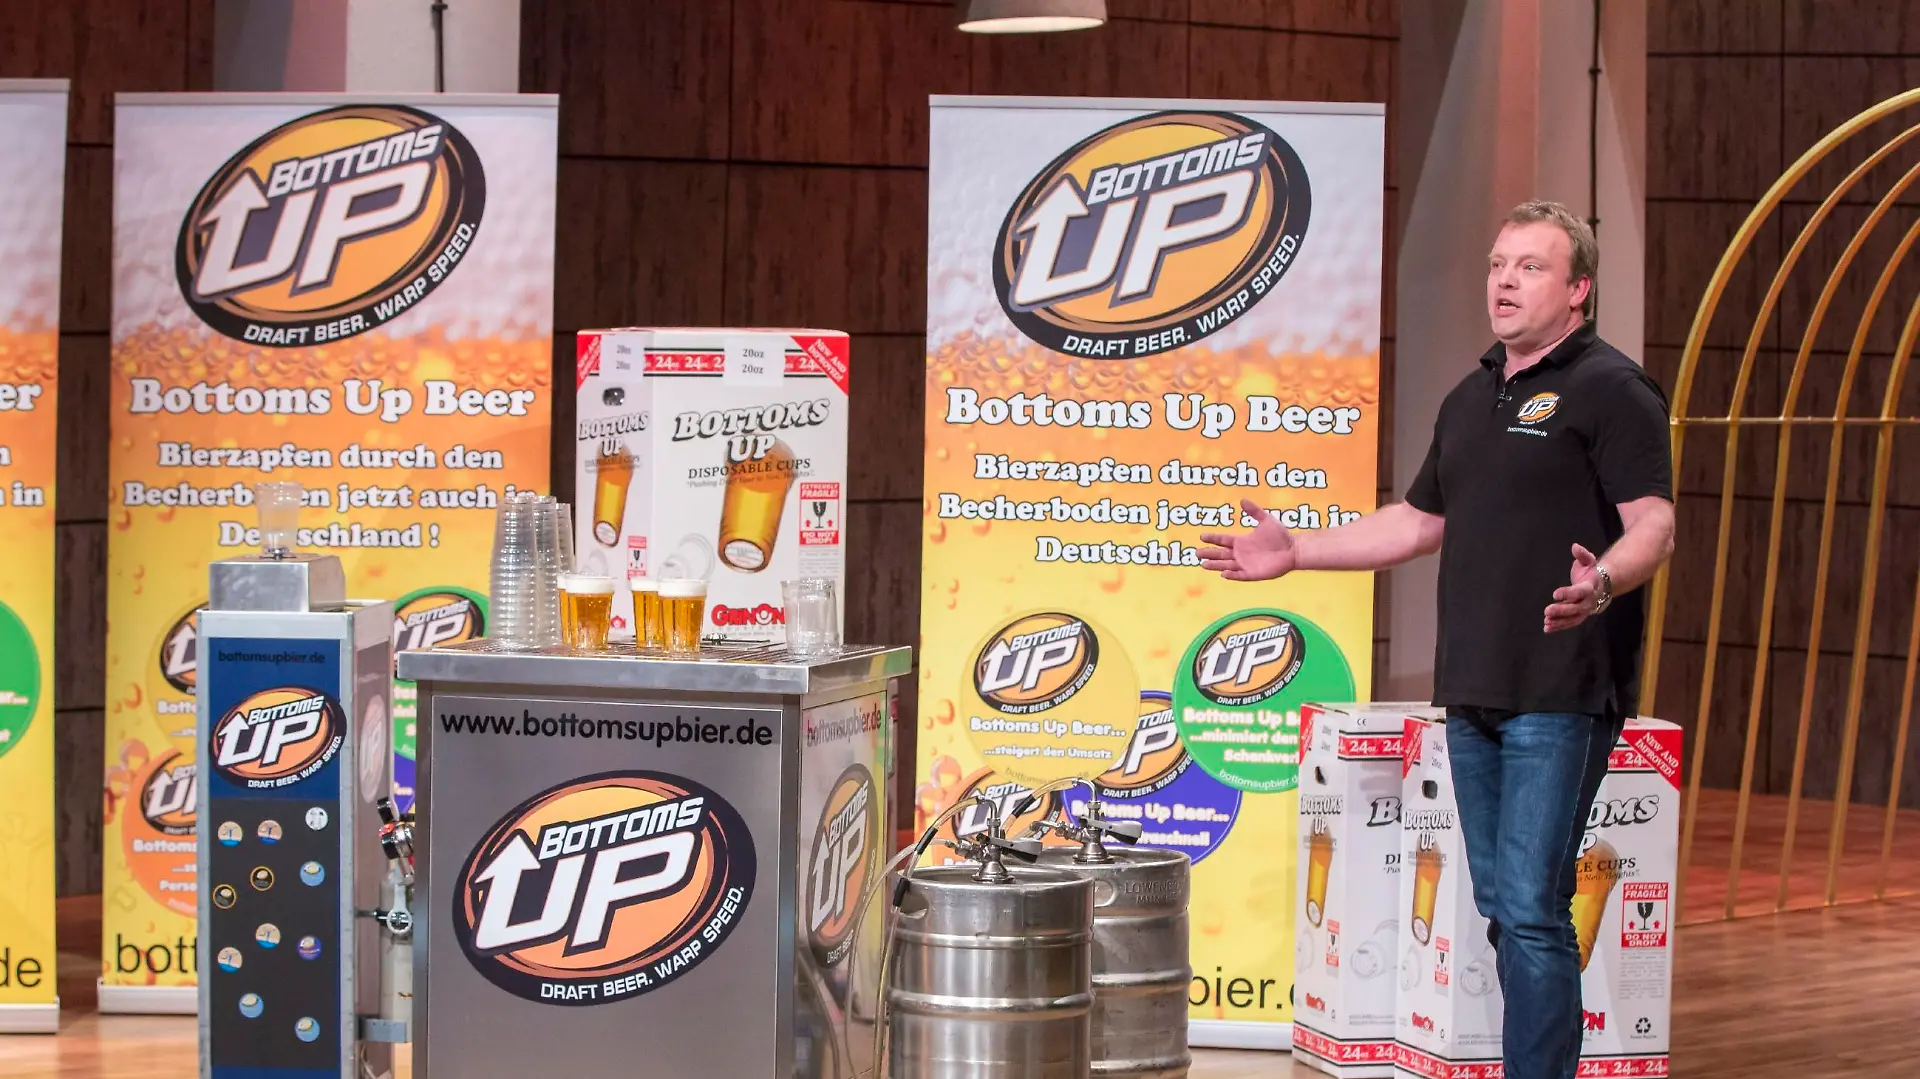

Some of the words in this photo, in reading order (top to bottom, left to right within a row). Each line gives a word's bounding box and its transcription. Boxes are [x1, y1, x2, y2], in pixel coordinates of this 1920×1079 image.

[267, 125, 442, 198] BOTTOMS
[1087, 132, 1265, 206] BOTTOMS
[198, 163, 431, 296] UP
[1014, 170, 1254, 304] UP
[244, 324, 310, 345] DRAFT
[314, 316, 370, 340] BEER.
[374, 276, 428, 322] WARP
[429, 221, 476, 282] SPEED.
[1063, 335, 1129, 357] DRAFT
[1134, 329, 1191, 354] BEER.
[1197, 290, 1251, 335] WARP
[1252, 233, 1300, 295] SPEED.
[743, 348, 764, 358] 20oz
[742, 364, 763, 374] 20oz
[0, 384, 43, 411] er
[130, 378, 330, 415] Bottoms
[343, 378, 413, 422] Up
[424, 380, 535, 417] Beer
[579, 411, 649, 440] BOTTOMS
[672, 398, 831, 442] BOTTOMS
[945, 387, 1152, 429] Bottoms
[1163, 393, 1235, 438] Up
[1245, 395, 1361, 434] Beer
[158, 443, 331, 472] Bierzapfen
[339, 444, 436, 469] durch
[444, 446, 502, 469] den
[602, 438, 624, 457] UP
[728, 434, 776, 463] UP
[688, 462, 772, 479] DISPOSABLE
[777, 458, 811, 471] CUPS
[974, 453, 1152, 487] Bierzapfen
[1159, 460, 1259, 488] durch
[1265, 462, 1327, 489] den
[12, 481, 44, 506] in
[123, 481, 330, 508] Becherben
[337, 484, 412, 513] jetzt
[419, 484, 497, 509] auch
[939, 493, 1150, 525] Becherboden
[1156, 500, 1235, 530] jetzt
[219, 521, 422, 547] Deschland
[1035, 536, 1209, 566] Deutschla
[407, 600, 470, 627] BOTTOMS
[1010, 622, 1082, 651] BOTTOMS
[1226, 622, 1291, 649] BOTTOMS
[218, 650, 326, 667] bottomsupbier.de
[982, 637, 1078, 692] UP
[1200, 637, 1286, 687] UP
[1001, 704, 1028, 713] DRAFT
[1029, 701, 1052, 712] BEER.
[1054, 688, 1076, 704] WARP
[1076, 663, 1096, 689] SPEED.
[1217, 696, 1241, 706] DRAFT
[1264, 681, 1284, 697] WARP
[248, 695, 325, 725] BOTTOMS
[1137, 709, 1175, 730] TTOM
[1183, 707, 1254, 725] Bottoms
[1257, 709, 1282, 730] Up
[218, 711, 321, 766] UP
[440, 709, 774, 748] www.bottomsupbier.de
[807, 703, 882, 747] bottomsupbier.de
[970, 716, 1041, 733] Bottoms
[1043, 719, 1068, 738] Up
[1072, 721, 1127, 737] Beer...
[1271, 731, 1298, 745] den
[248, 779, 275, 788] DRAFT
[276, 775, 301, 787] BEER.
[300, 760, 323, 779] WARP
[322, 735, 342, 762] SPEED.
[984, 746, 1041, 758] ...steigert
[1042, 747, 1065, 757] den
[1067, 748, 1112, 759] Umsatz
[1113, 723, 1178, 776] P
[1635, 738, 1676, 778] IMPROVED!
[1642, 732, 1664, 751] NEW
[1661, 752, 1679, 768] AND
[985, 782, 1028, 799] BOTT
[1102, 788, 1130, 798] DRAFT
[1131, 786, 1155, 797] BEER.
[1156, 772, 1178, 789] WARP
[1178, 755, 1194, 773] SPE
[829, 780, 869, 849] BOTTOMS
[1144, 802, 1171, 824] Up
[1173, 803, 1230, 822] Beer...
[1301, 795, 1343, 815] BOTTOMS
[1405, 808, 1455, 830] BOTTOMS
[539, 797, 704, 860] BOTTOMS
[1313, 816, 1327, 836] UP
[1420, 831, 1436, 851] UP
[1577, 833, 1597, 860] P
[812, 809, 866, 932] UP
[1597, 858, 1637, 872] CUPS
[475, 832, 696, 949] UP
[1624, 890, 1667, 898] FRAGILE!
[541, 983, 598, 1001] DRAFT
[603, 973, 654, 997] BEER.
[655, 940, 702, 977] WARP
[702, 885, 745, 943] SPEED.
[1629, 939, 1660, 947] DROP!
